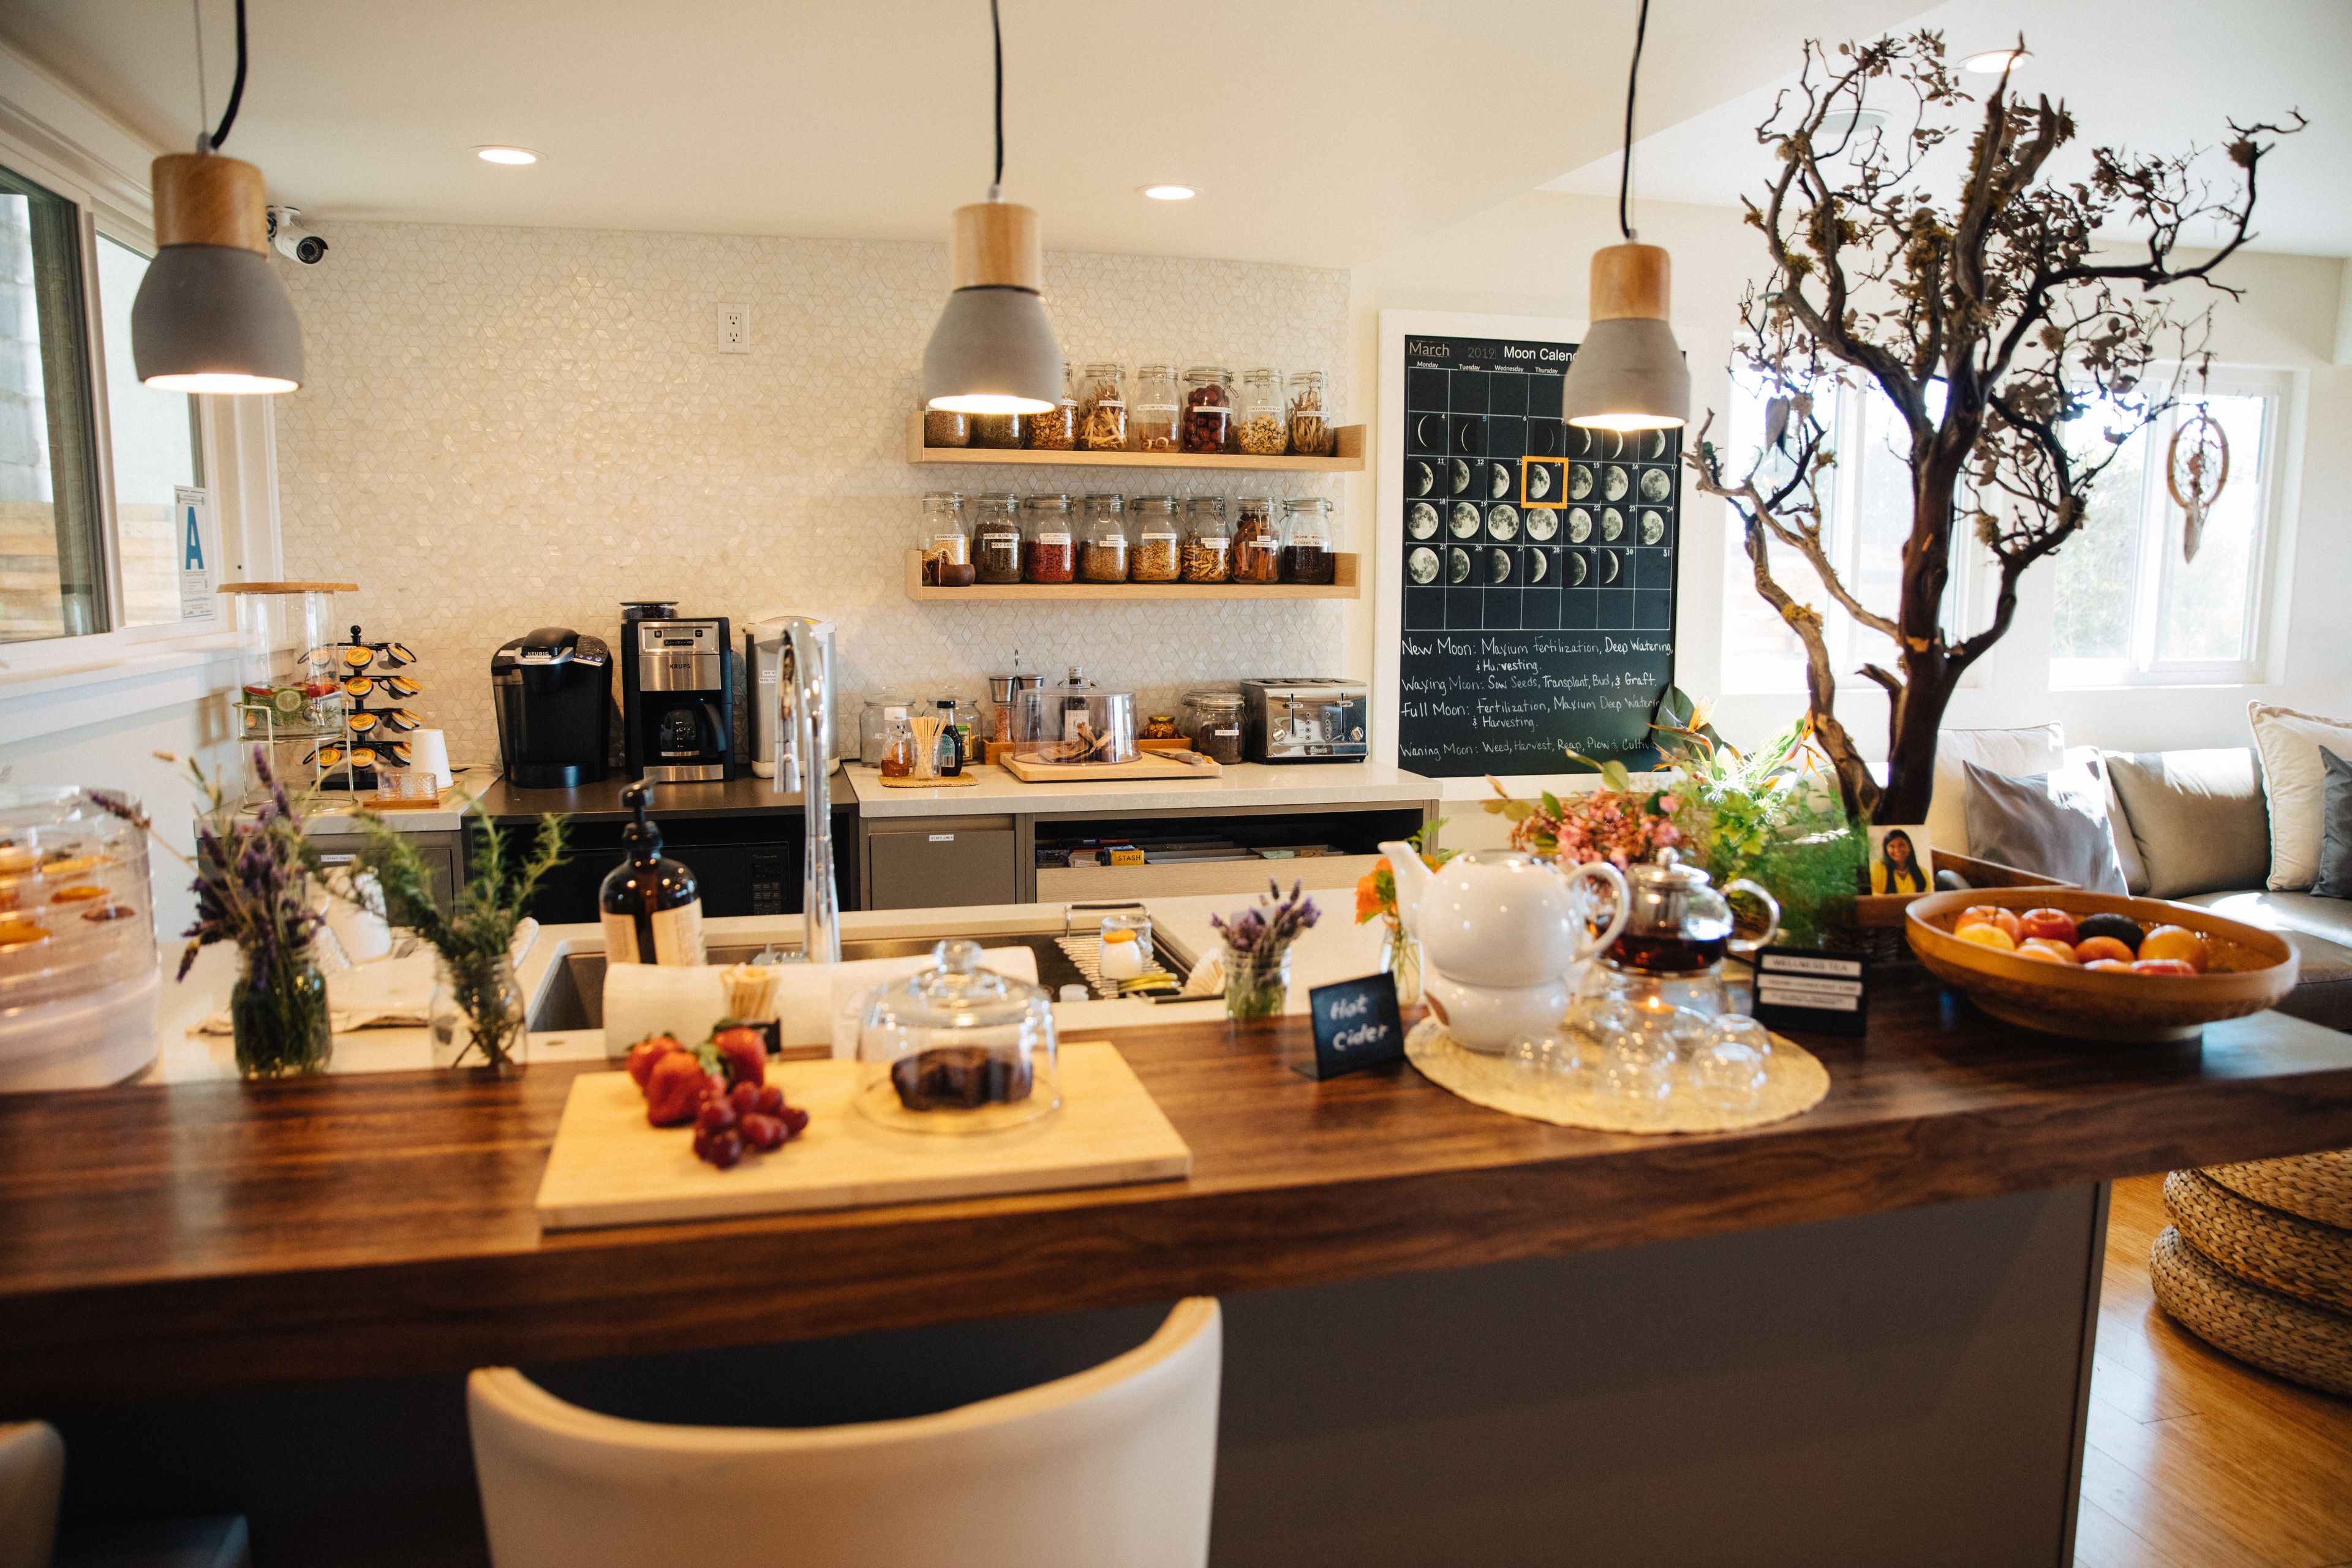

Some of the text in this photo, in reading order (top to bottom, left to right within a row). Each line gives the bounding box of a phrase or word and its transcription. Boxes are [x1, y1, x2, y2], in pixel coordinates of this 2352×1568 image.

[1409, 342, 1449, 356] March
[1468, 347, 1495, 359] 2019
[1504, 346, 1536, 360] Moon
[186, 506, 204, 570] A
[1401, 635, 1673, 656] New Moon: Maxium Fertilization, Deep Watering,
[1483, 658, 1542, 675] Harvesting.
[1401, 676, 1447, 696] Waxing
[1449, 675, 1484, 691] Moon:
[1488, 674, 1507, 690] Sow
[1511, 675, 1540, 688] Seeds,
[1542, 674, 1591, 690] Transplant,
[1593, 674, 1613, 688] Bud,
[1624, 672, 1657, 687] Graft.
[1401, 695, 1661, 717] Full Moon: Fertilization, Maxium Deep Waterin
[1482, 715, 1539, 732] Harvesting.
[1400, 742, 1441, 761] Waning
[1444, 742, 1479, 755] Moon:
[1482, 739, 1512, 755] Weed,
[1514, 737, 1555, 752] Harvest,
[1558, 739, 1585, 752] Reap,
[1587, 736, 1610, 749] Plow
[1330, 993, 1370, 1020] Hot
[1332, 1023, 1389, 1052] Cider
